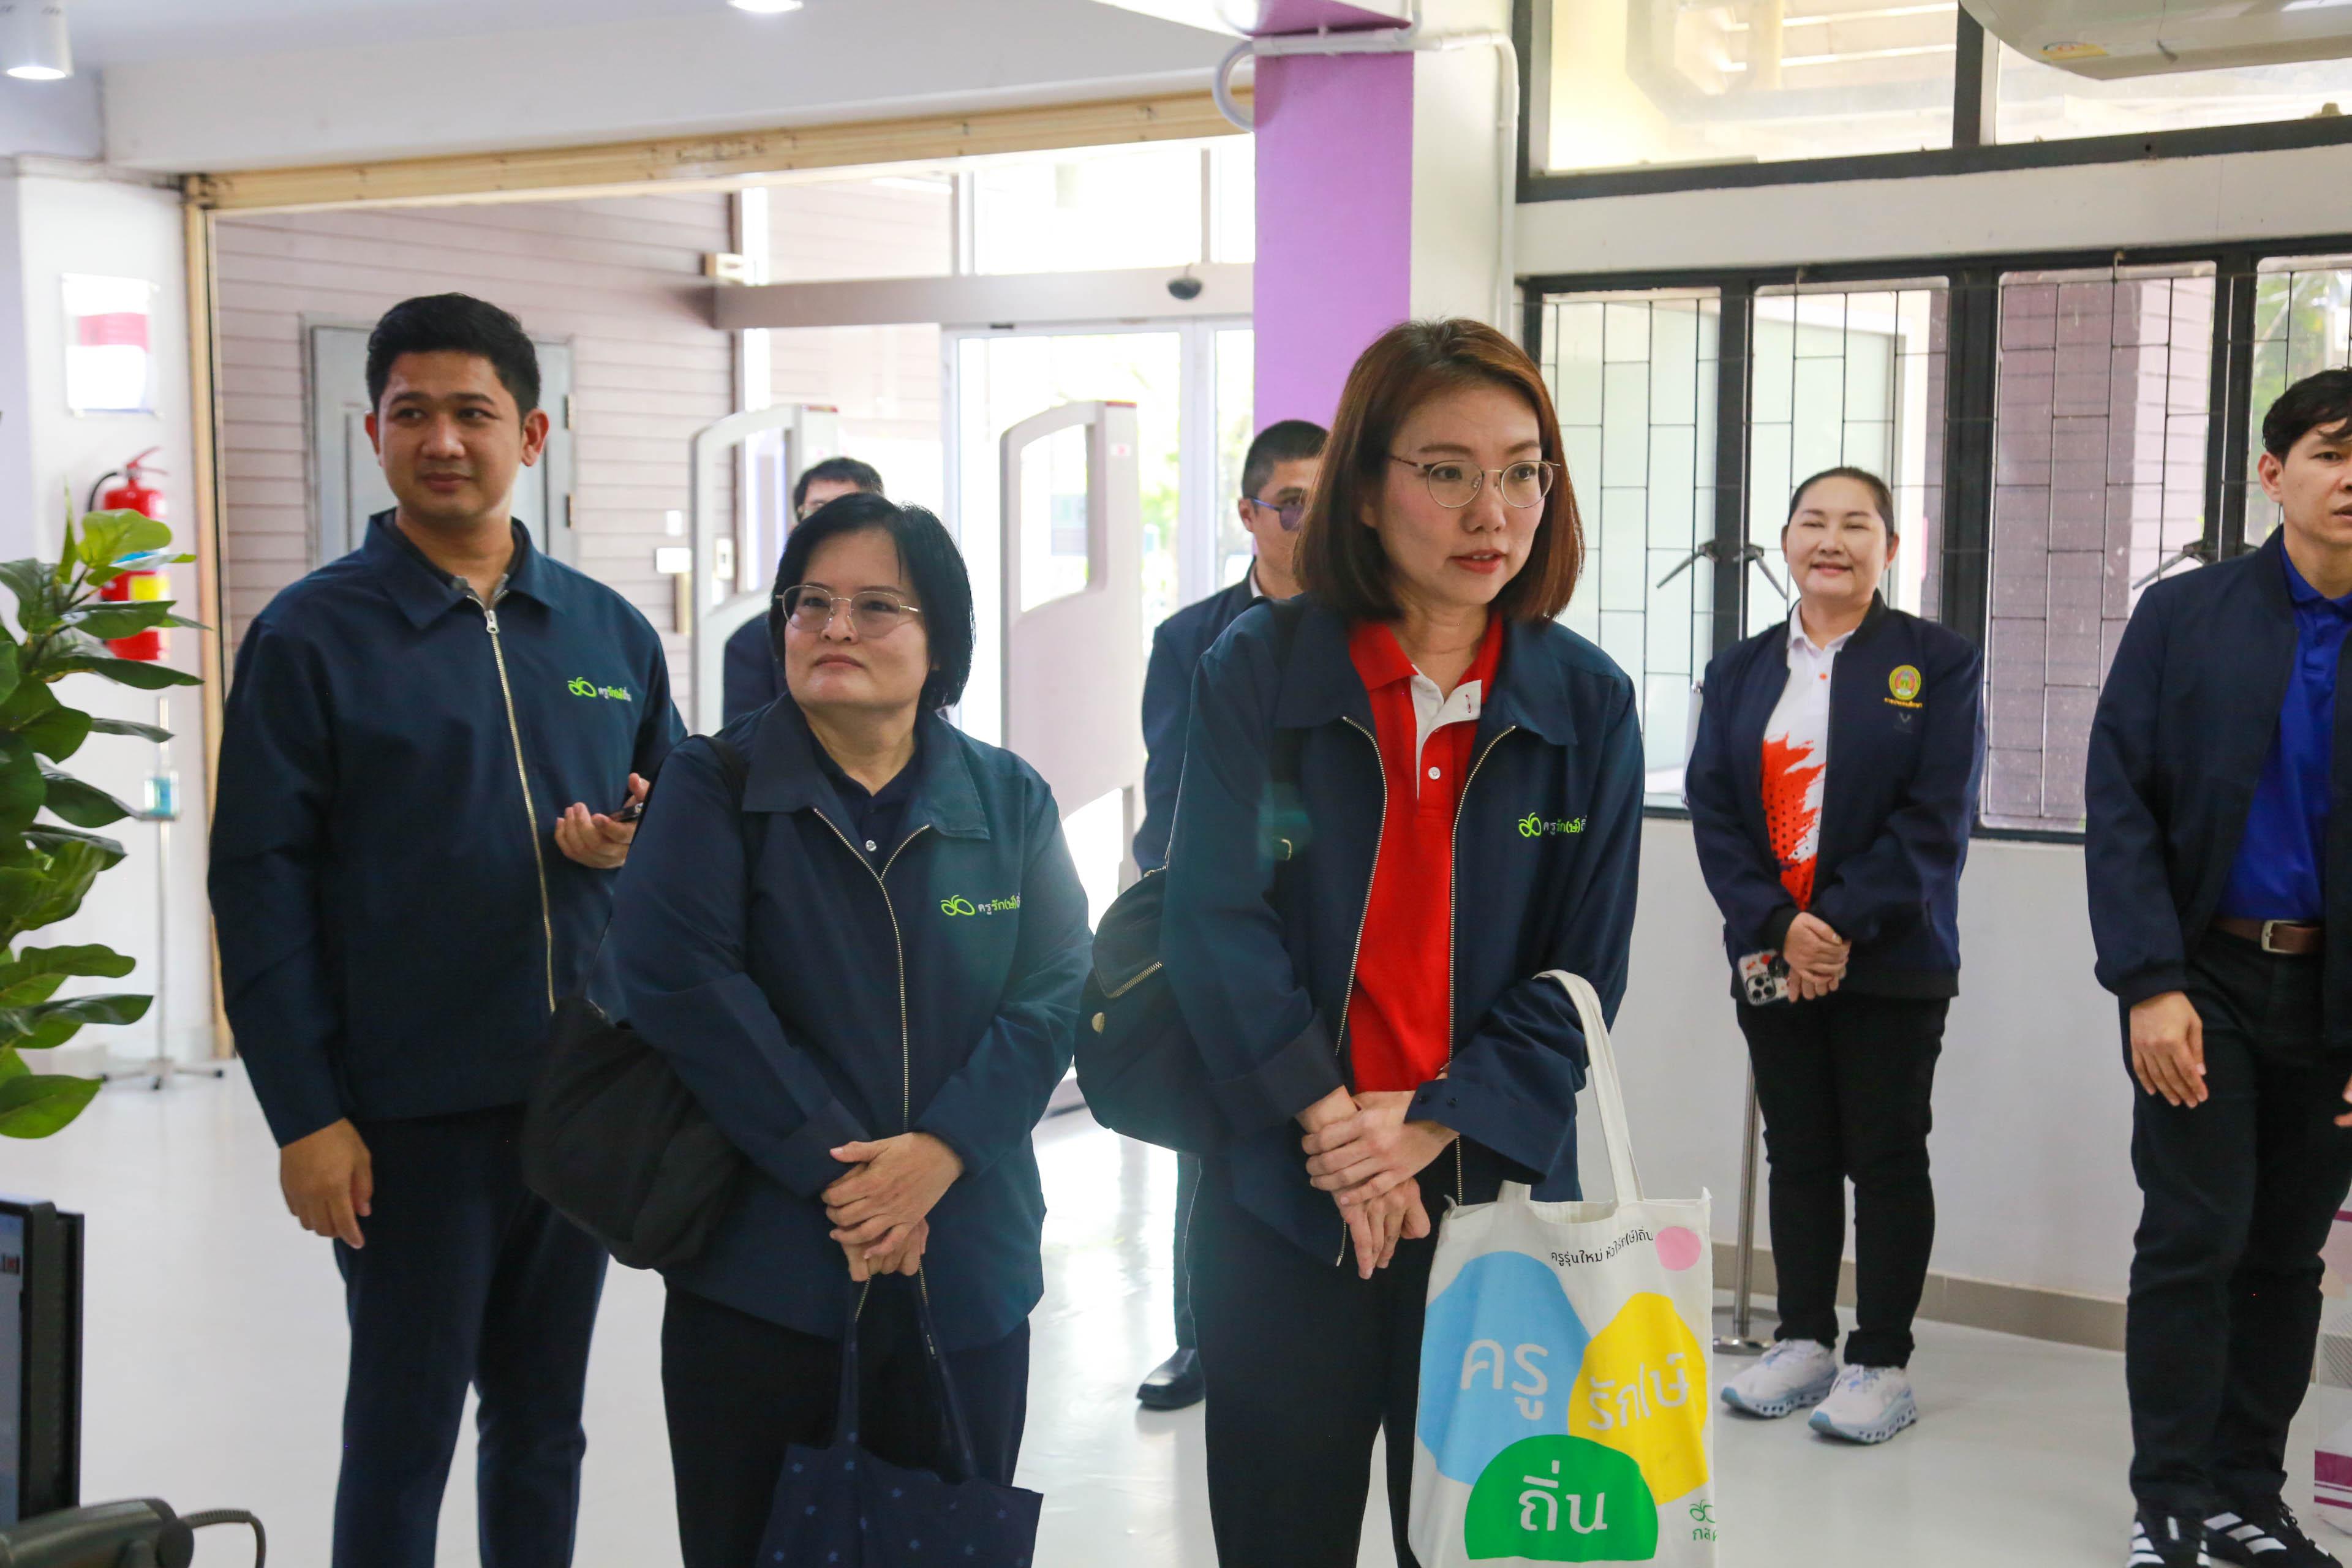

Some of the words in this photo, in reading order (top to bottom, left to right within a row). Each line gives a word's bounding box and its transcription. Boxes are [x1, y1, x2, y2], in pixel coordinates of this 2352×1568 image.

[1551, 1248, 1602, 1267] ครูรุ่นใหม่
[1460, 1338, 1549, 1420] ครู
[1588, 1352, 1690, 1431] รัก(ษ์
[1518, 1460, 1608, 1534] ถิ่น
